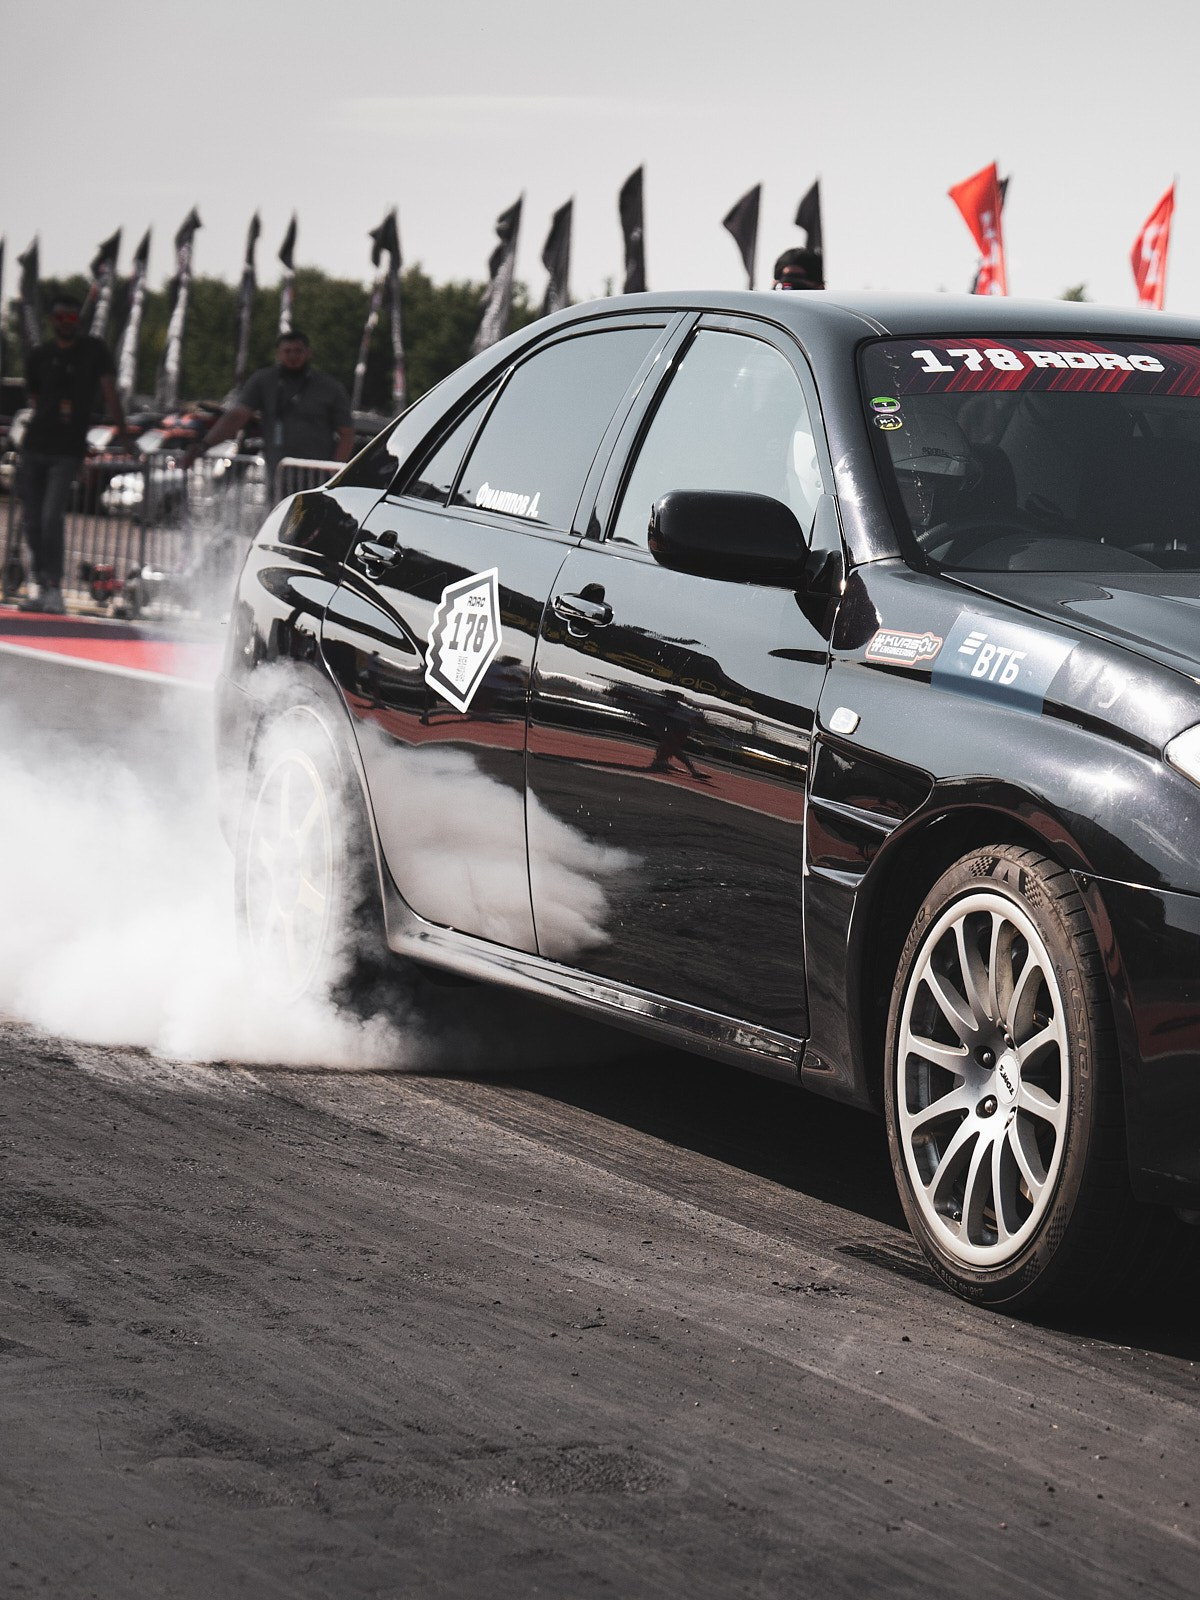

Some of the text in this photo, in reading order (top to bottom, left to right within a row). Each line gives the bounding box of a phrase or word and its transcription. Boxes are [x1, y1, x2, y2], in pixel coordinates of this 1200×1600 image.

[911, 348, 1165, 373] 178 RDRC
[448, 613, 488, 653] 178
[971, 643, 1027, 685] ВТБ
